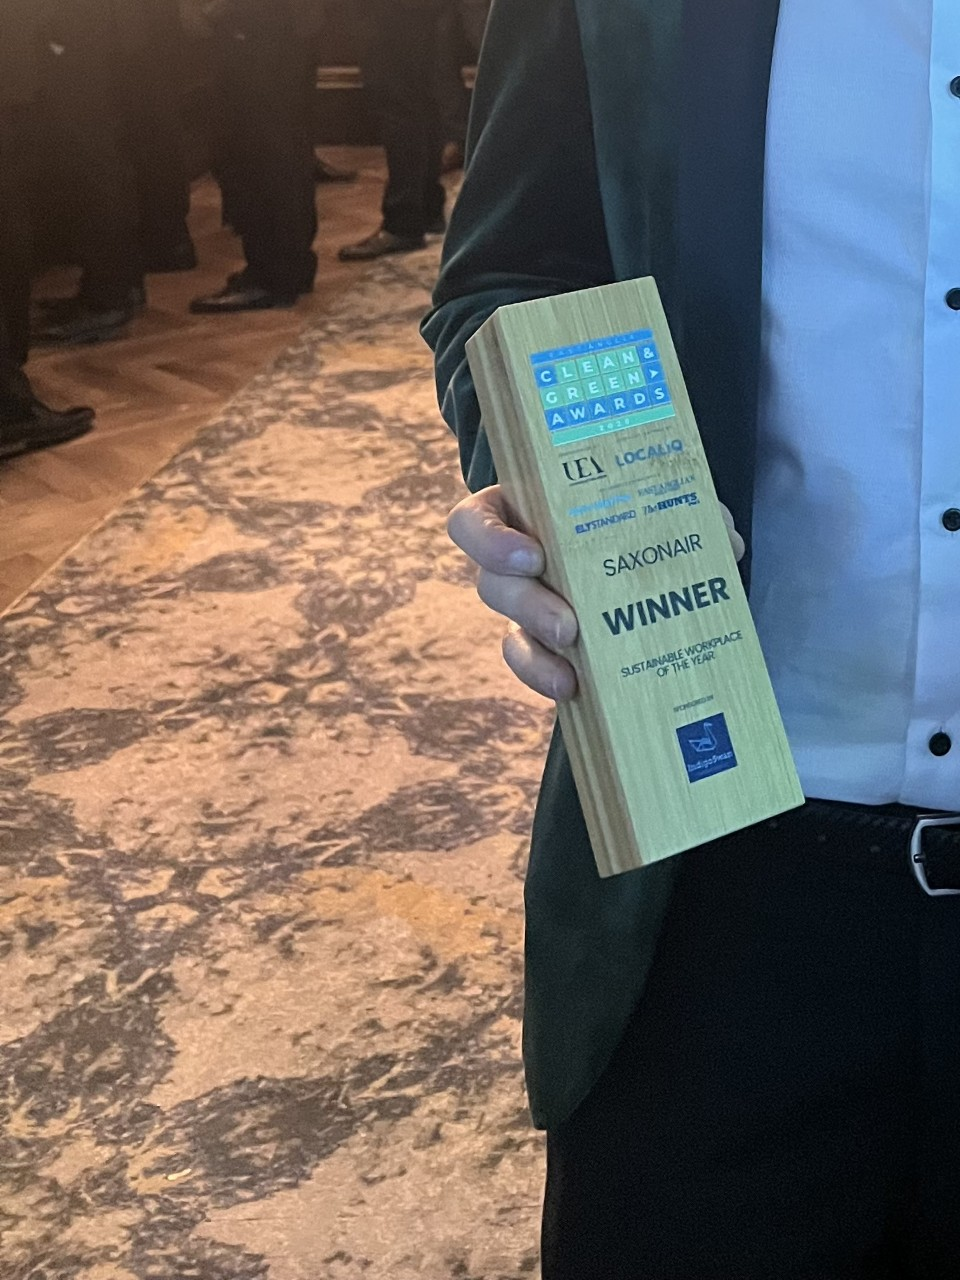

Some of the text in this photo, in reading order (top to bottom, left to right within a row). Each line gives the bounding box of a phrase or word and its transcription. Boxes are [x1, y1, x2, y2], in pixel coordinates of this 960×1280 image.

[540, 347, 655, 383] CLEAN &
[546, 371, 641, 404] GREEN
[551, 387, 665, 426] AWARDS
[603, 533, 703, 577] SAXONAIR
[601, 577, 730, 636] WINNER
[620, 630, 743, 678] SUSTAINABLE WORKPLACE
[656, 650, 716, 677] OF THE YEAR
